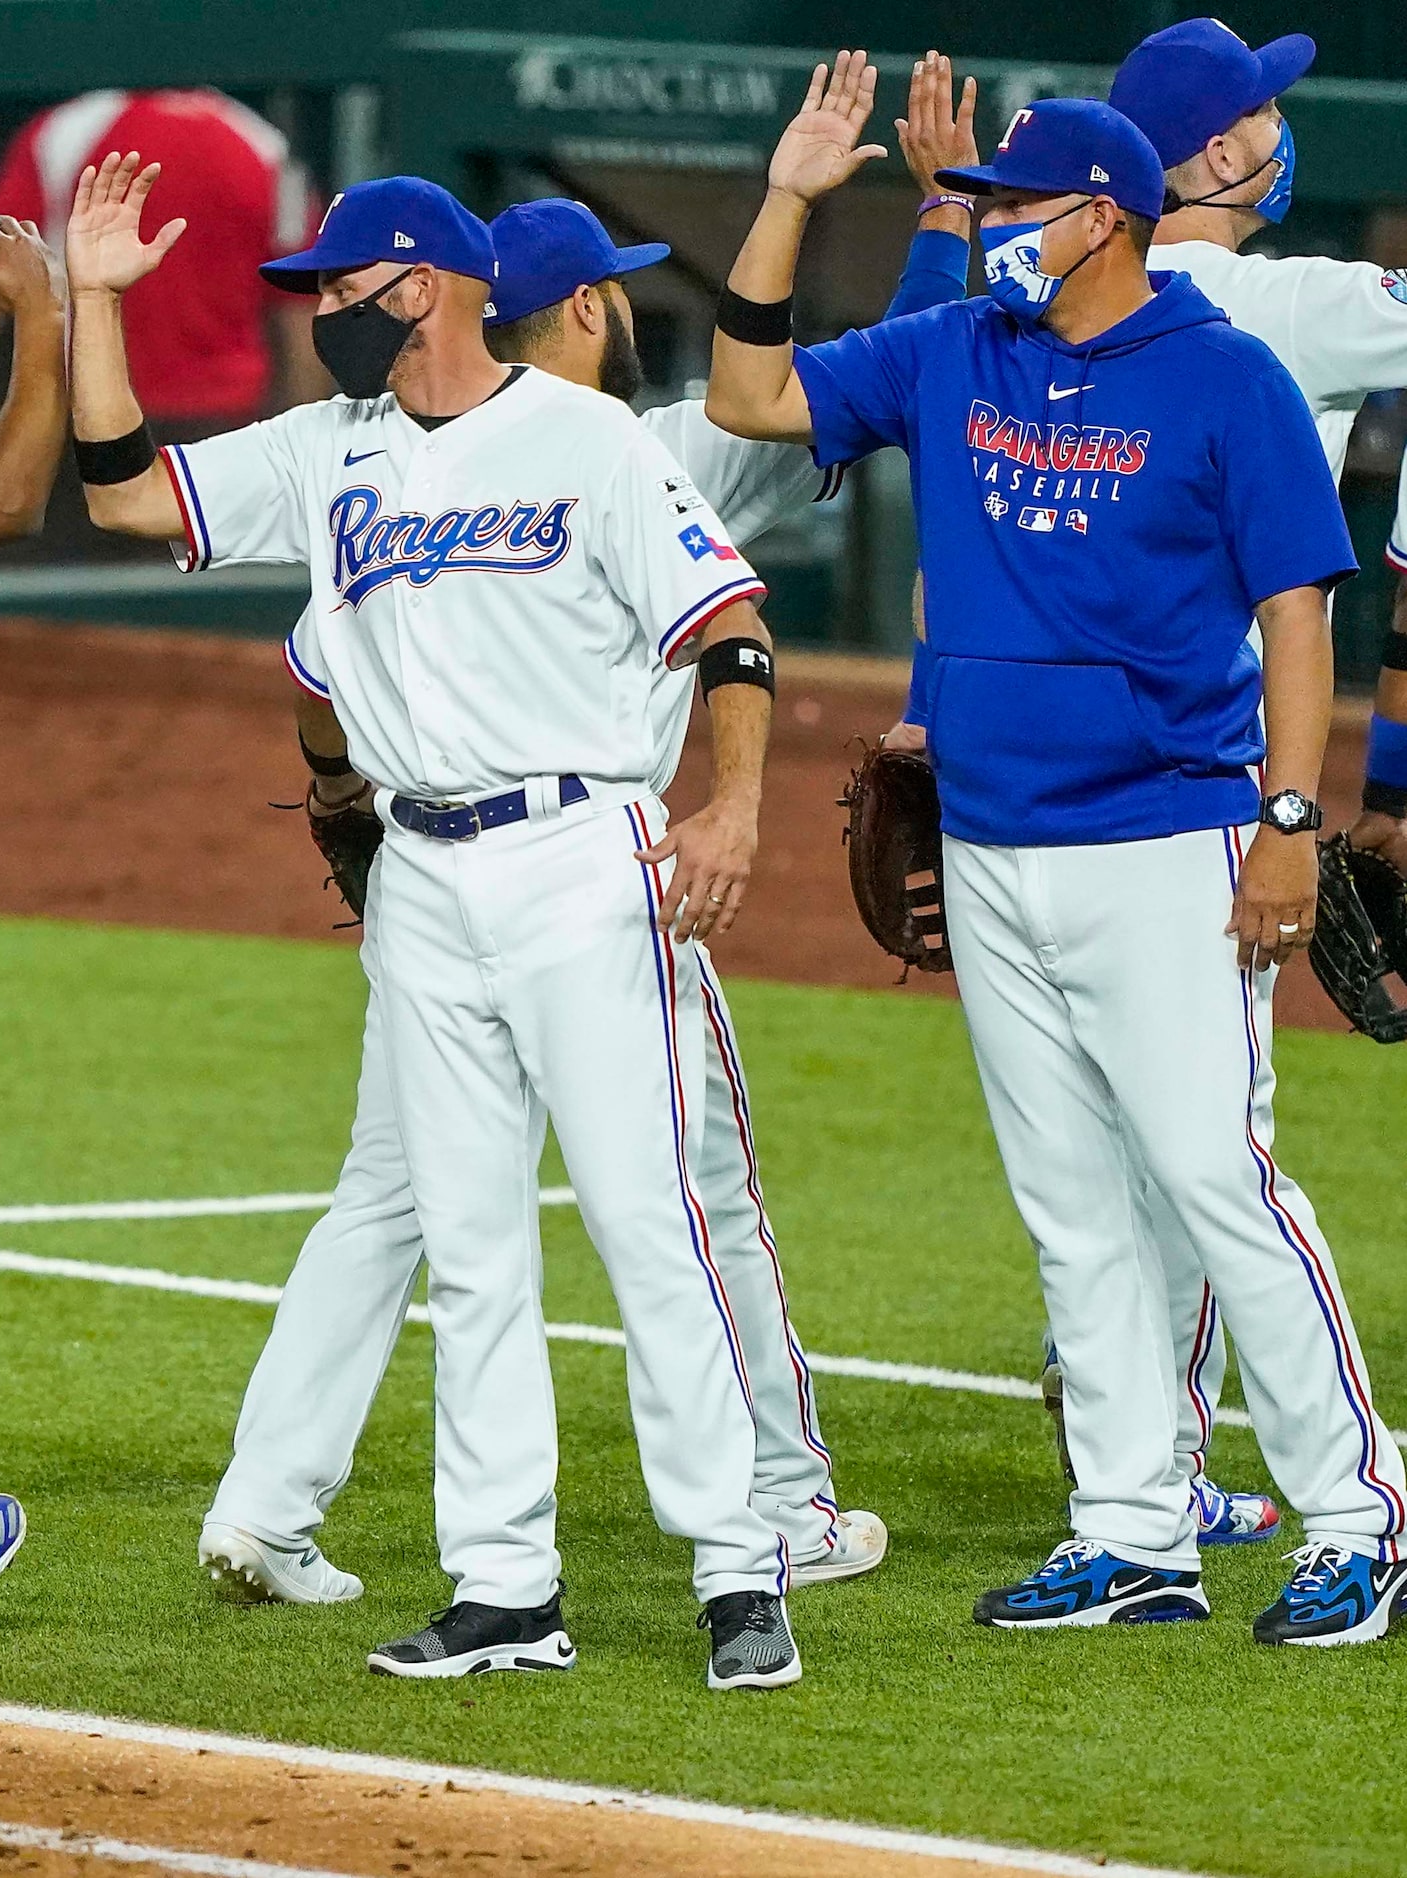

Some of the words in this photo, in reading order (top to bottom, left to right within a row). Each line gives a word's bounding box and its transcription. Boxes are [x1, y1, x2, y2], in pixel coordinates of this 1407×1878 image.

[967, 398, 1152, 475] RANGERS
[972, 456, 1120, 501] ASEBALL
[328, 484, 580, 614] Rangers
